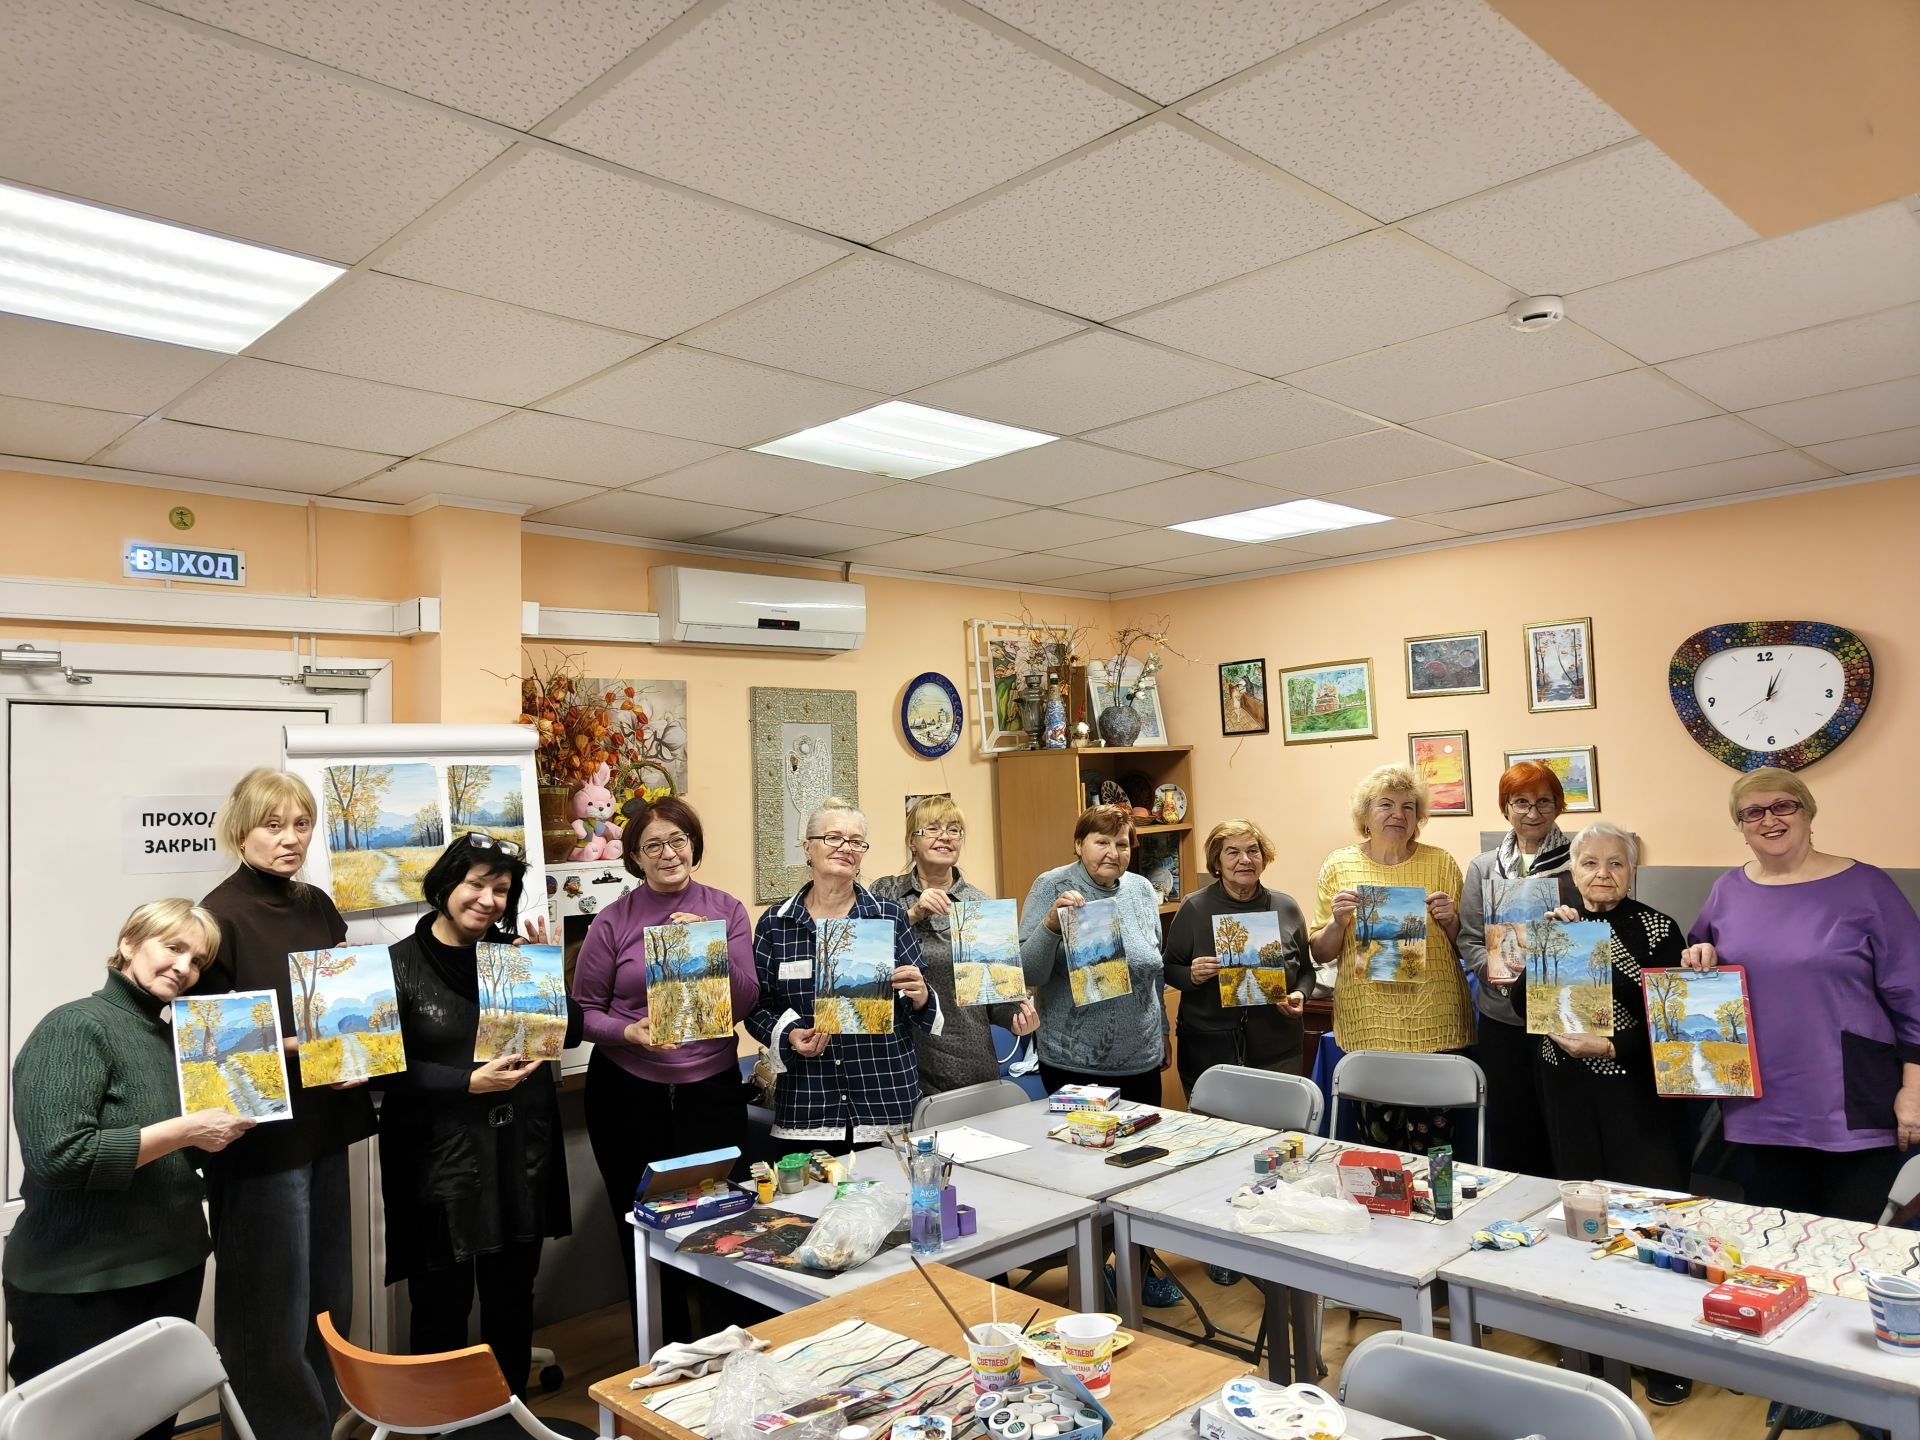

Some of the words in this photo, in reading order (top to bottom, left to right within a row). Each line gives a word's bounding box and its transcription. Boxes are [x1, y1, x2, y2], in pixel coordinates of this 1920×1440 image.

[136, 548, 234, 579] ВЫХОД
[1756, 652, 1774, 662] 12
[1824, 688, 1834, 699] 3
[1707, 697, 1716, 708] 9
[1767, 735, 1776, 745] 6
[144, 837, 217, 853] ЗАКРЫТ
[920, 1187, 939, 1198] АКВА
